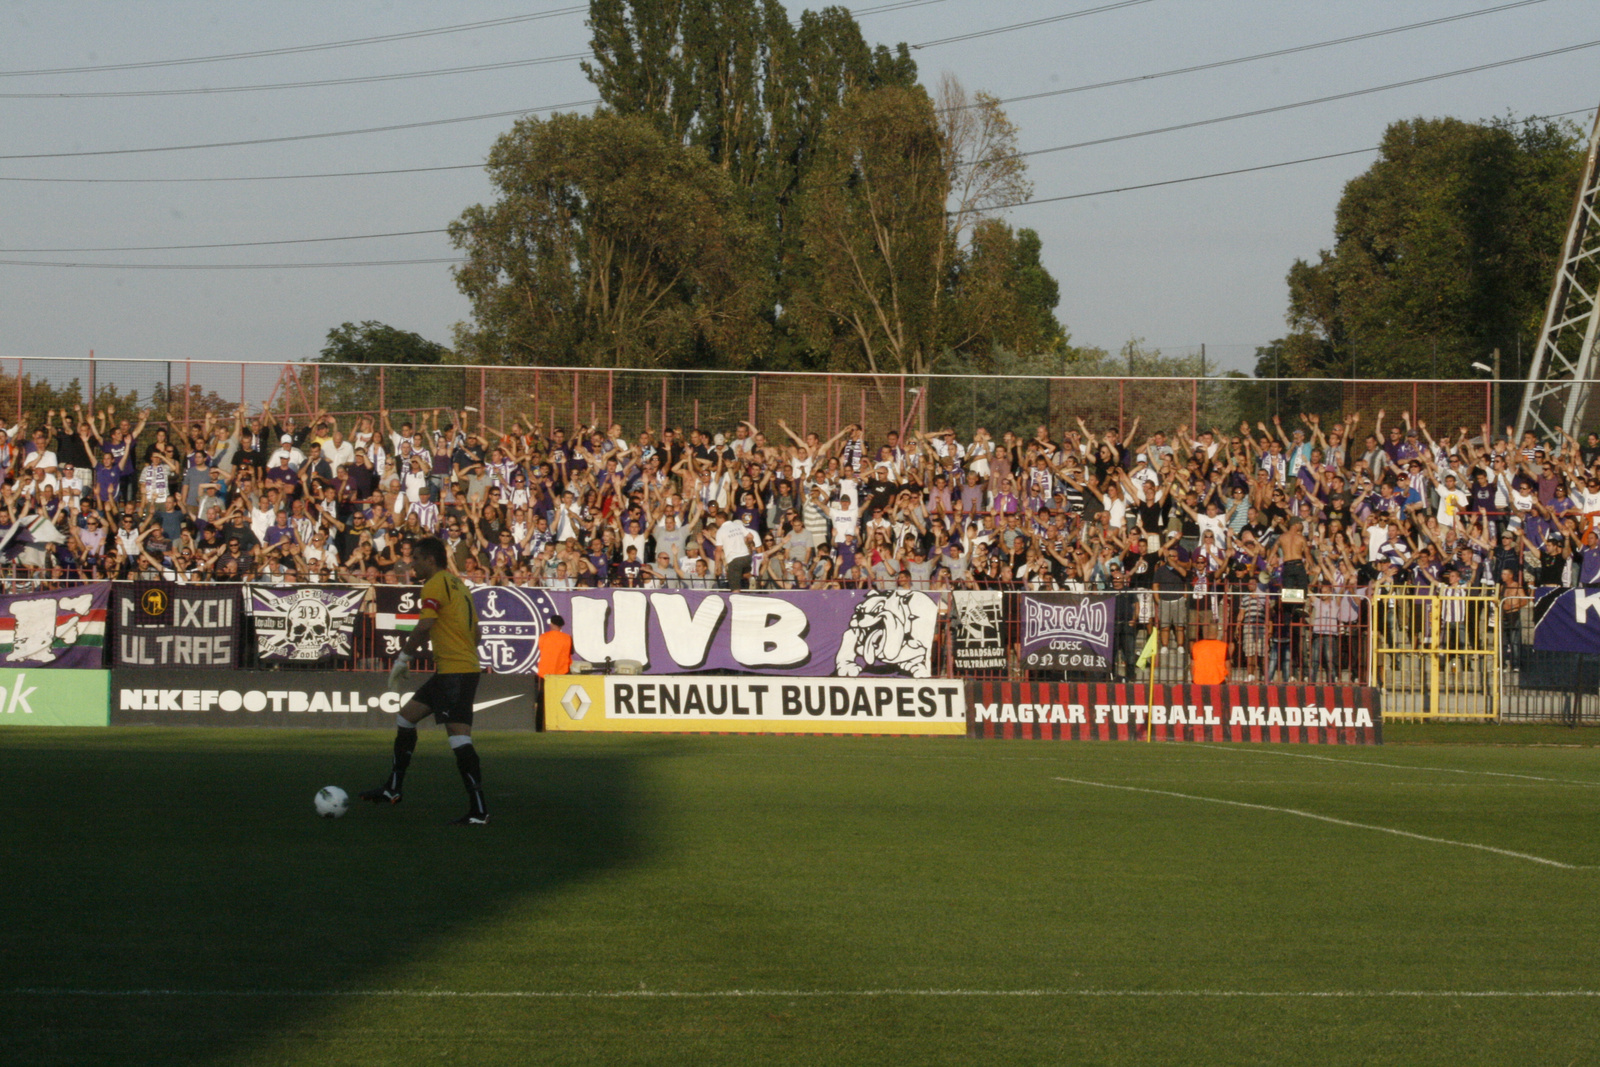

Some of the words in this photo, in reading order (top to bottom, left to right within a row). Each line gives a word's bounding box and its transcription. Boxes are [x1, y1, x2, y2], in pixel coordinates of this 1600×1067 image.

[1025, 597, 1108, 642] BRIGÁD
[121, 634, 231, 665] ULTRAS
[1027, 653, 1054, 667] ON
[1058, 653, 1107, 668] TOUR
[613, 683, 769, 715] RENAULT
[974, 703, 1086, 724] MAGYAR
[1094, 704, 1220, 725] FUTBALL
[1229, 703, 1374, 727] AKADÉMIA
